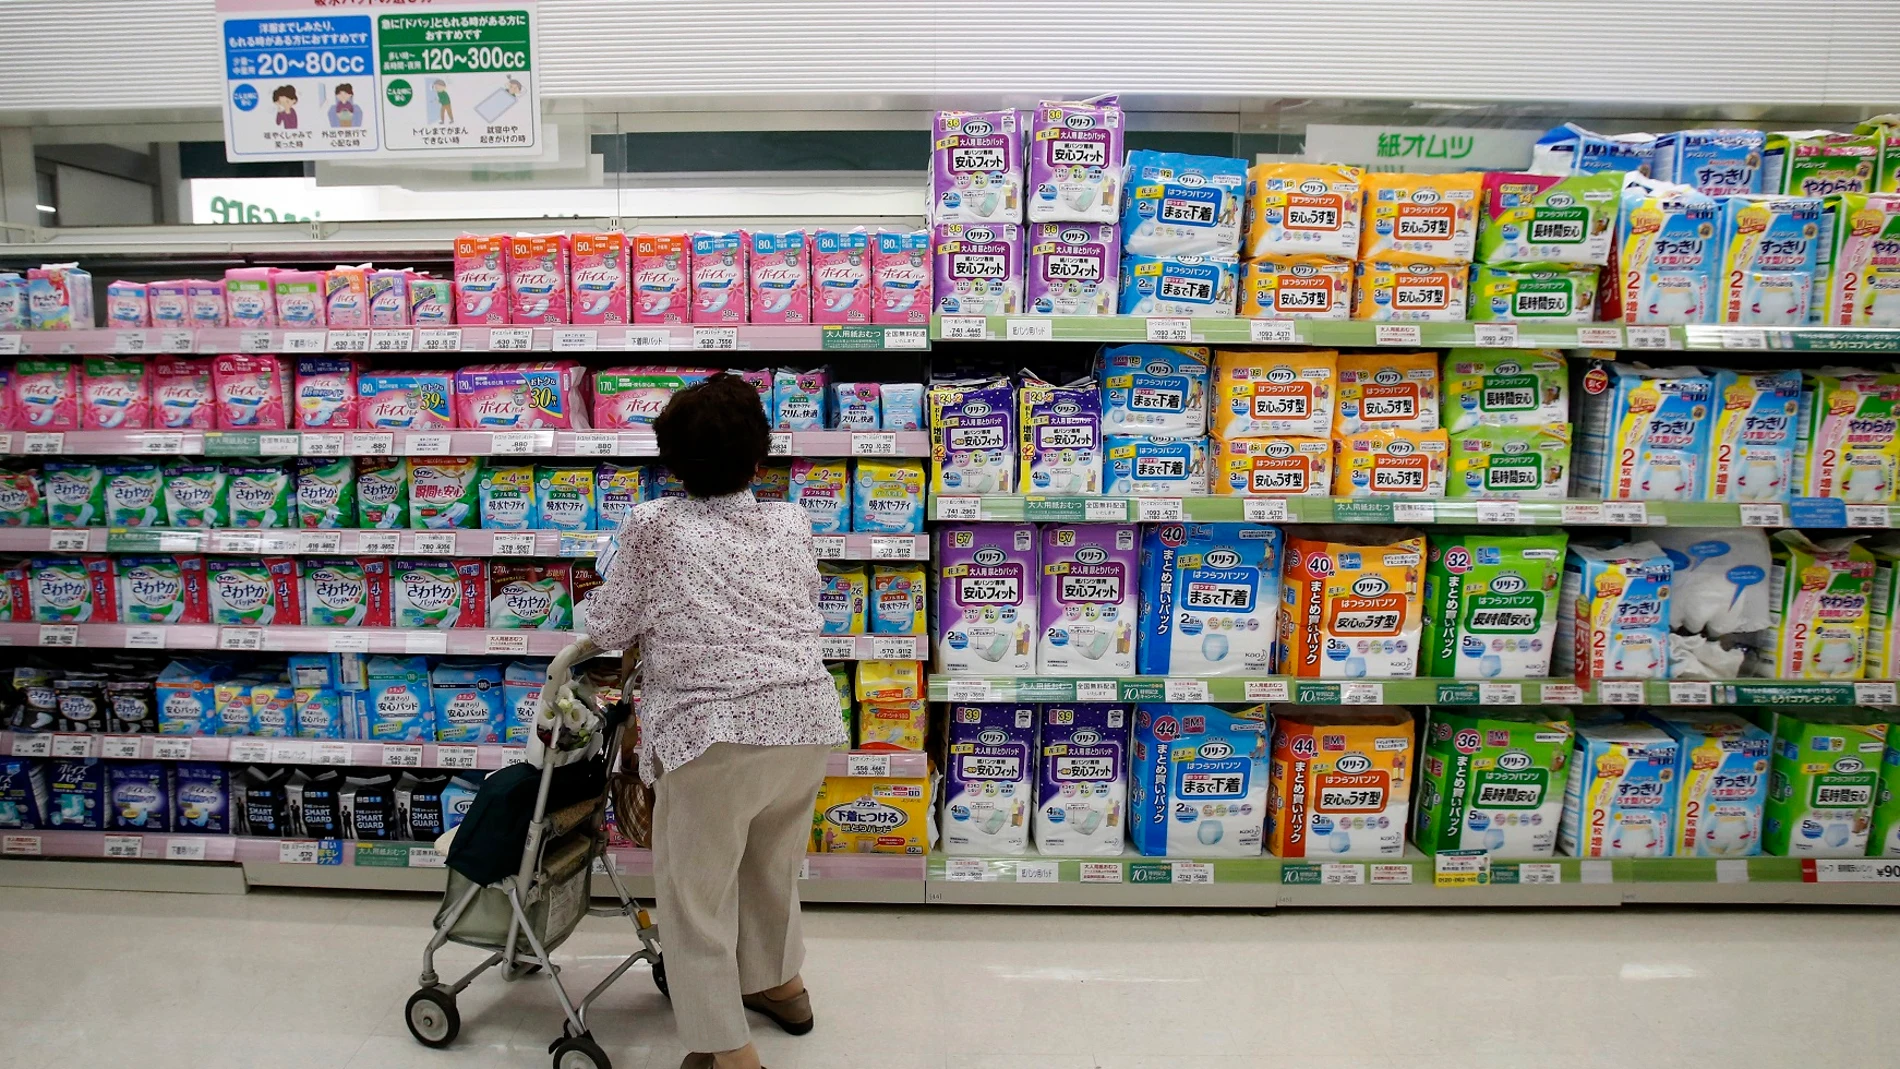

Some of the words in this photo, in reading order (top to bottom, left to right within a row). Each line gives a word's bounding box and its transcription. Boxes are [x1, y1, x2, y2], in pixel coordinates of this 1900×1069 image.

[425, 30, 482, 41] おすすめです
[412, 127, 469, 136] トイレまでがまん
[330, 139, 360, 147] 心配な時
[422, 135, 460, 145] できない時
[1377, 133, 1475, 158] 紙オムツ
[1055, 150, 1103, 162] 安心フィット
[955, 157, 1002, 168] 安心フィット
[1164, 204, 1213, 221] まるで下着
[1290, 210, 1335, 225] 安心のうす型
[1401, 219, 1448, 235] 安心のうす型
[1533, 224, 1580, 240] 長時間安心
[697, 269, 724, 279] ポイズ
[758, 269, 785, 279] ポイズ
[820, 268, 848, 278] ポイズ
[882, 269, 909, 279] ポイズ
[956, 264, 1003, 276] 安心フィット
[1050, 264, 1098, 275] 安心フィット
[461, 273, 487, 283] ポイズ
[516, 273, 543, 284] ポイズ
[640, 272, 667, 282] ポイズ
[1163, 281, 1210, 298] まるで下着
[1399, 290, 1444, 305] 安心のうす型
[1518, 296, 1565, 311] 長時間安心
[1134, 393, 1180, 408] まるで下着
[1257, 399, 1305, 413] 安心のうす型
[964, 434, 1002, 446] 安心フィット
[1256, 472, 1302, 487] 安心のうす型
[115, 486, 152, 498] さわやか
[488, 501, 525, 510] 吸水セーフティ
[547, 501, 583, 511] 吸水セーフティ
[799, 500, 838, 510] 吸水セーフティ
[869, 500, 911, 511] 吸水セーフティ
[956, 532, 971, 544] 57
[1059, 531, 1073, 542] 57
[42, 582, 85, 595] さわやか
[132, 582, 176, 594] さわやか
[221, 584, 267, 597] さわやか
[316, 584, 362, 597] さわやか
[407, 585, 455, 598] さわやか
[964, 586, 1016, 599] 安心フィット
[1065, 586, 1117, 598] 安心フィット
[1159, 549, 1176, 635] まとめ買いパック
[507, 595, 550, 607] さわやか
[1190, 588, 1247, 605] まるで下着
[1306, 580, 1322, 664] まとめ買いパック
[1337, 614, 1396, 628] 安心のうす型
[1442, 576, 1459, 659] まとめ買いパック
[1473, 611, 1533, 626] 長時間安心
[378, 701, 418, 711] 安心パッド
[447, 708, 487, 717] 安心パッド
[1156, 723, 1177, 735] 44
[1293, 739, 1314, 753] 44
[1153, 744, 1168, 823] まとめ買いパック
[1184, 777, 1240, 793] まるで下着
[1322, 791, 1381, 806] 安心のうす型
[1448, 756, 1468, 836] まとめ買いパック
[1481, 788, 1536, 803] 長時間安心
[1817, 787, 1868, 804] 長時間安心
[1290, 761, 1305, 843] まとめ買いパック
[249, 807, 273, 815] SMART
[304, 807, 330, 815] SMART
[412, 813, 439, 821] SMART
[836, 811, 898, 822] 下着につける
[357, 813, 382, 822] SMART
[412, 819, 439, 827] GUARD
[357, 821, 383, 829] GUARD
